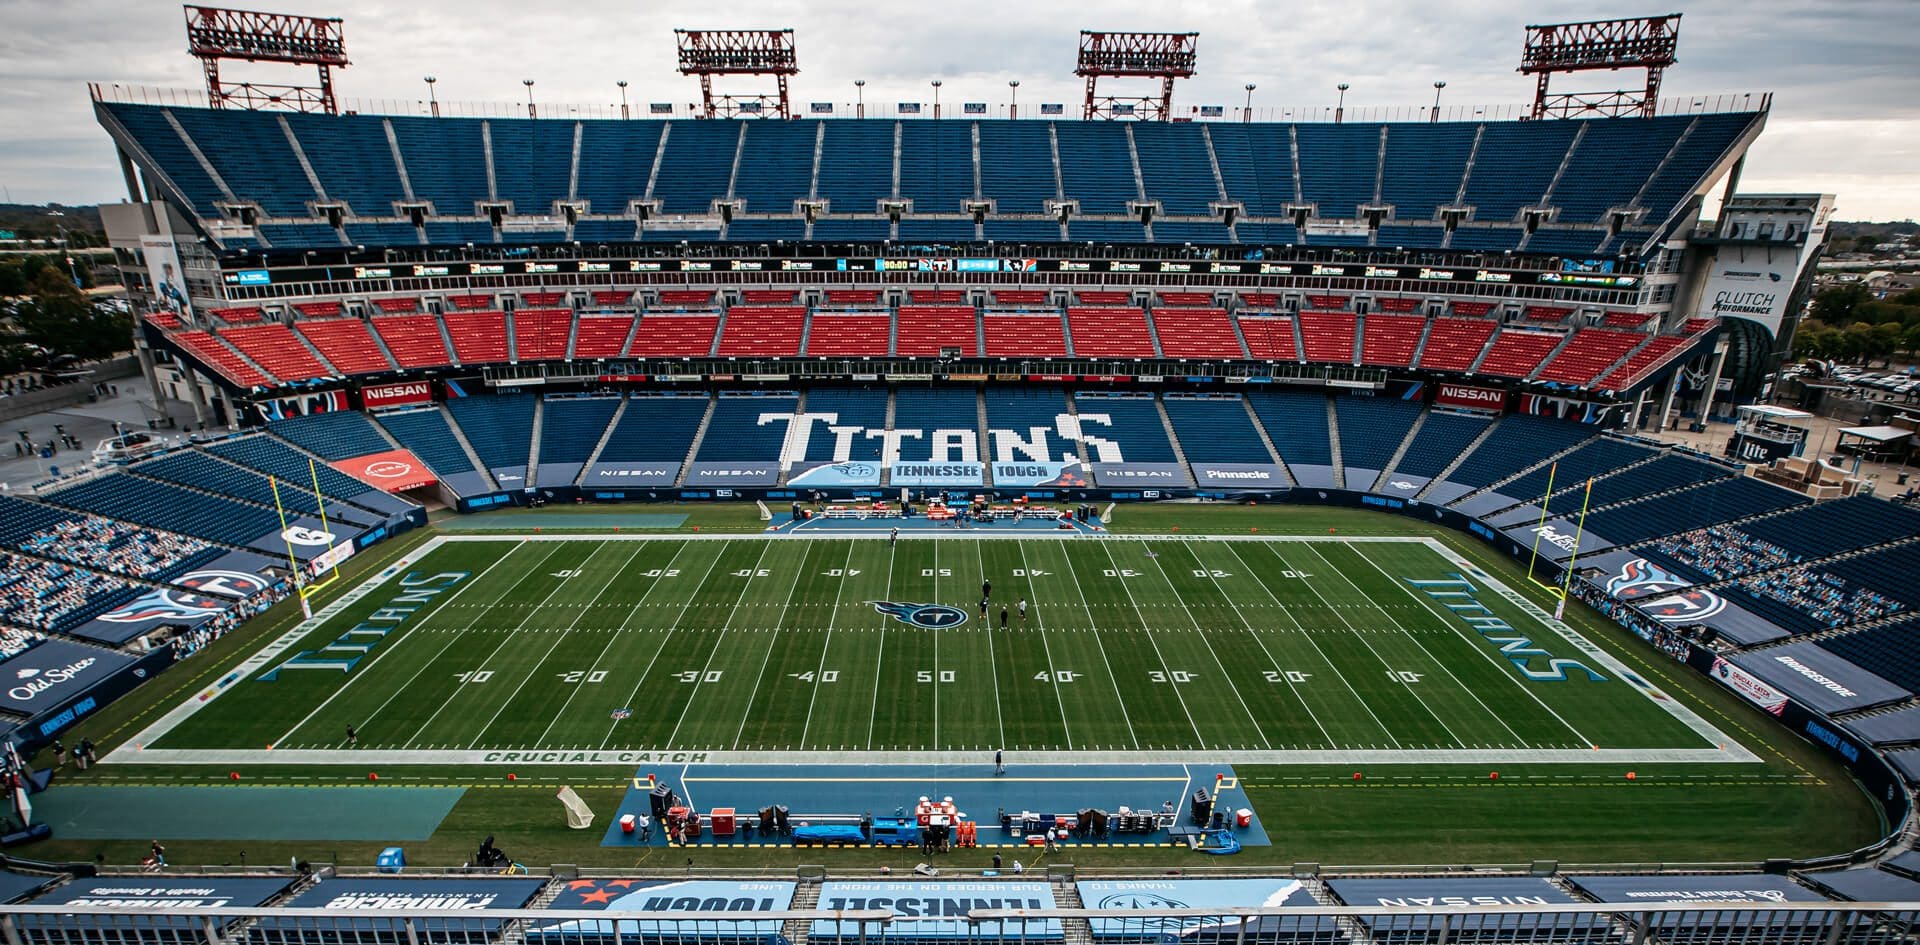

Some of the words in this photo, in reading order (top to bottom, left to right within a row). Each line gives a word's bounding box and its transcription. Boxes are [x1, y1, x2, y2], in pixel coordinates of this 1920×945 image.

[1715, 291, 1776, 306] CLUTCH
[1712, 302, 1774, 315] PERFORMANCE
[366, 384, 428, 400] NISSAN
[1441, 386, 1502, 402] NISSAN
[757, 411, 1124, 472] TITANS
[1742, 441, 1769, 460] Lite
[600, 469, 666, 477] NISSAN
[700, 469, 767, 477] NISSAN
[896, 465, 979, 477] TENNESSEE
[996, 465, 1048, 477] TOUGH
[1105, 470, 1172, 478] NISSAN
[1206, 468, 1271, 480] Pinnacle
[399, 481, 426, 491] NISSAN
[1531, 525, 1579, 551] FedEx
[255, 570, 472, 682] TITANS
[1401, 572, 1609, 682] TITANS
[8, 674, 49, 700] Old
[44, 656, 96, 687] Spice
[462, 670, 496, 683] 10
[563, 670, 610, 683] 20
[678, 670, 724, 683] 30
[798, 670, 841, 683] 40
[916, 670, 956, 683] 50
[1033, 670, 1075, 683] 40
[1147, 670, 1190, 683] 30
[1261, 670, 1305, 683] 20
[1385, 670, 1415, 683] 10
[1774, 655, 1858, 698] BRIDGESTONE
[484, 752, 606, 763] CRUCIAL
[617, 752, 708, 763] CATCH
[90, 887, 148, 896] Benefits
[150, 887, 163, 896] &
[164, 887, 215, 896] Health
[1091, 882, 1109, 890] TO
[1115, 882, 1176, 890] THANKS
[1626, 889, 1700, 899] Thomas
[1700, 889, 1746, 899] Saint
[324, 896, 494, 910] Pinnacle
[641, 897, 776, 917] TOUGH
[1377, 896, 1548, 907] NISSAN
[828, 898, 1046, 920] TENNESSEE
